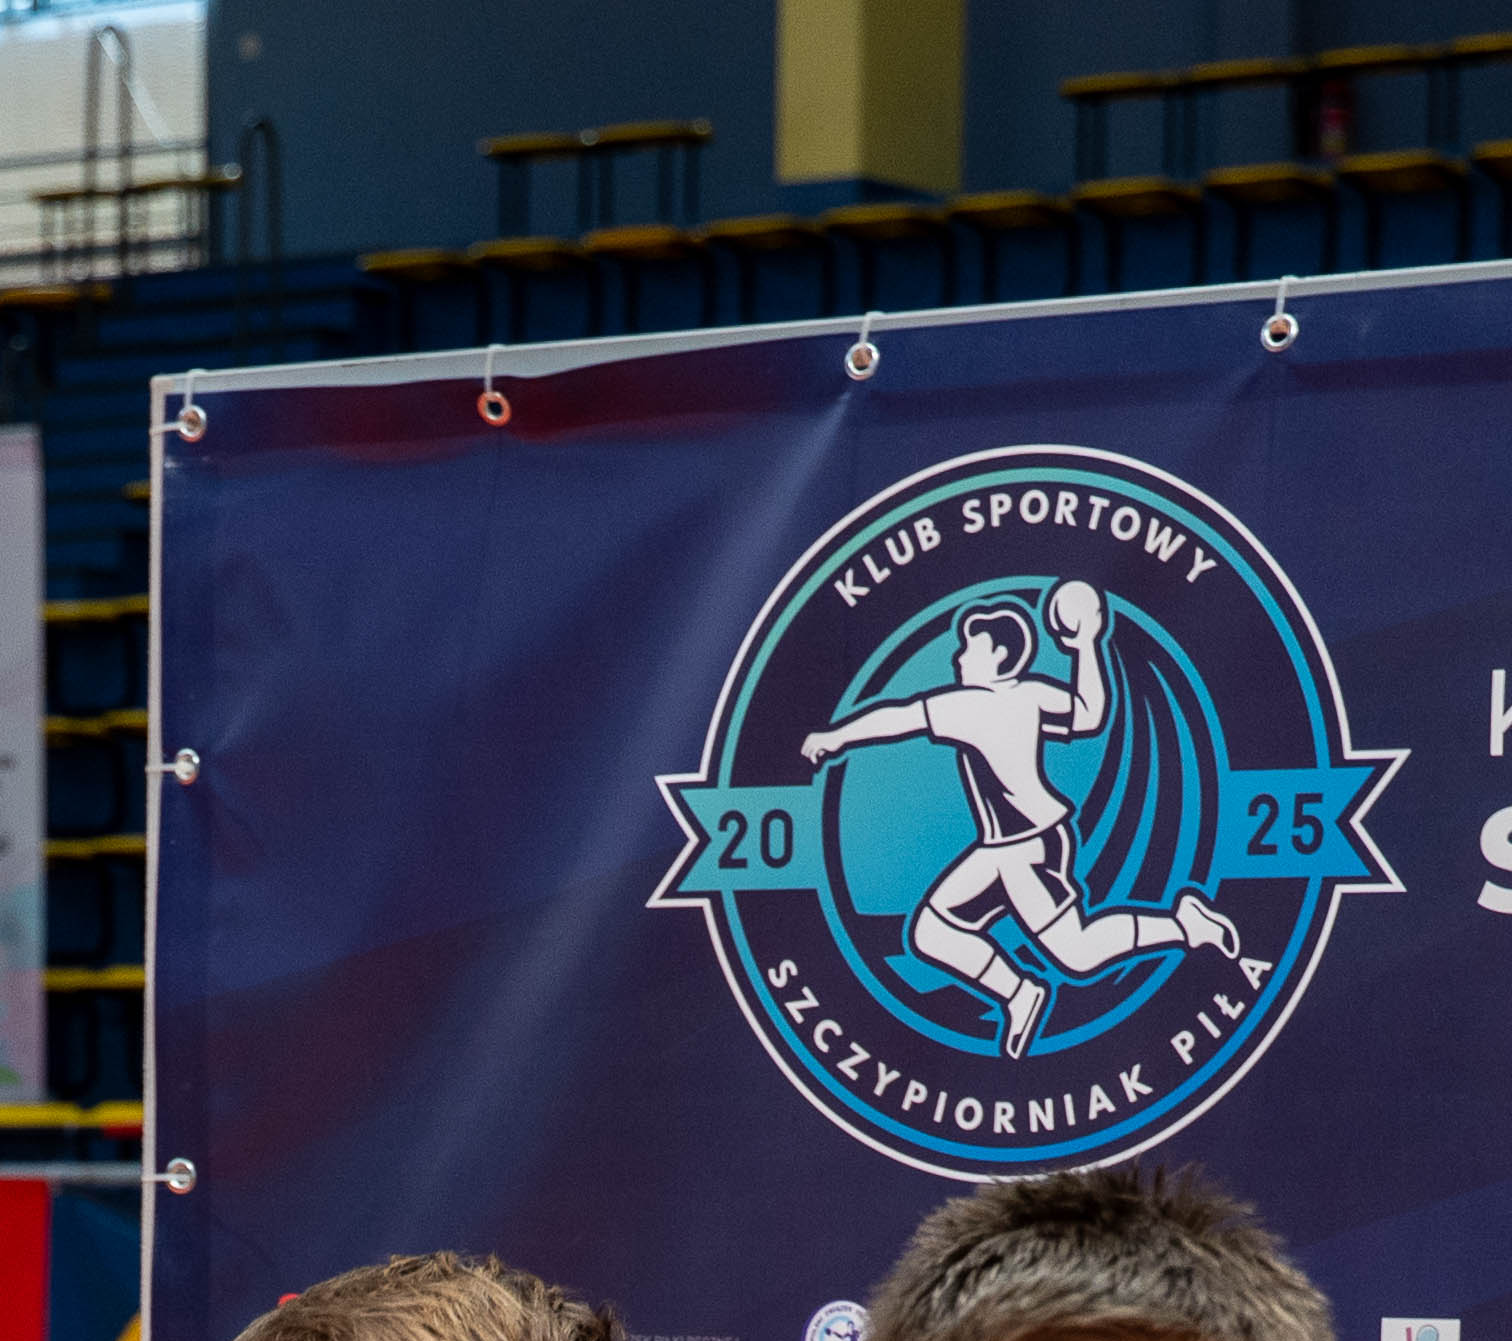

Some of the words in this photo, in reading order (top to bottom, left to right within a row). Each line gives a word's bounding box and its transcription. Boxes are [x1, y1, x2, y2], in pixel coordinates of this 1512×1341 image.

[833, 517, 942, 607] KLUB
[961, 489, 1217, 586] SPORTOWY
[717, 809, 793, 869] 20
[1246, 794, 1324, 855] 25
[768, 958, 1154, 1134] SZCZYPIORNIAK
[1171, 957, 1274, 1065] PIŁA
